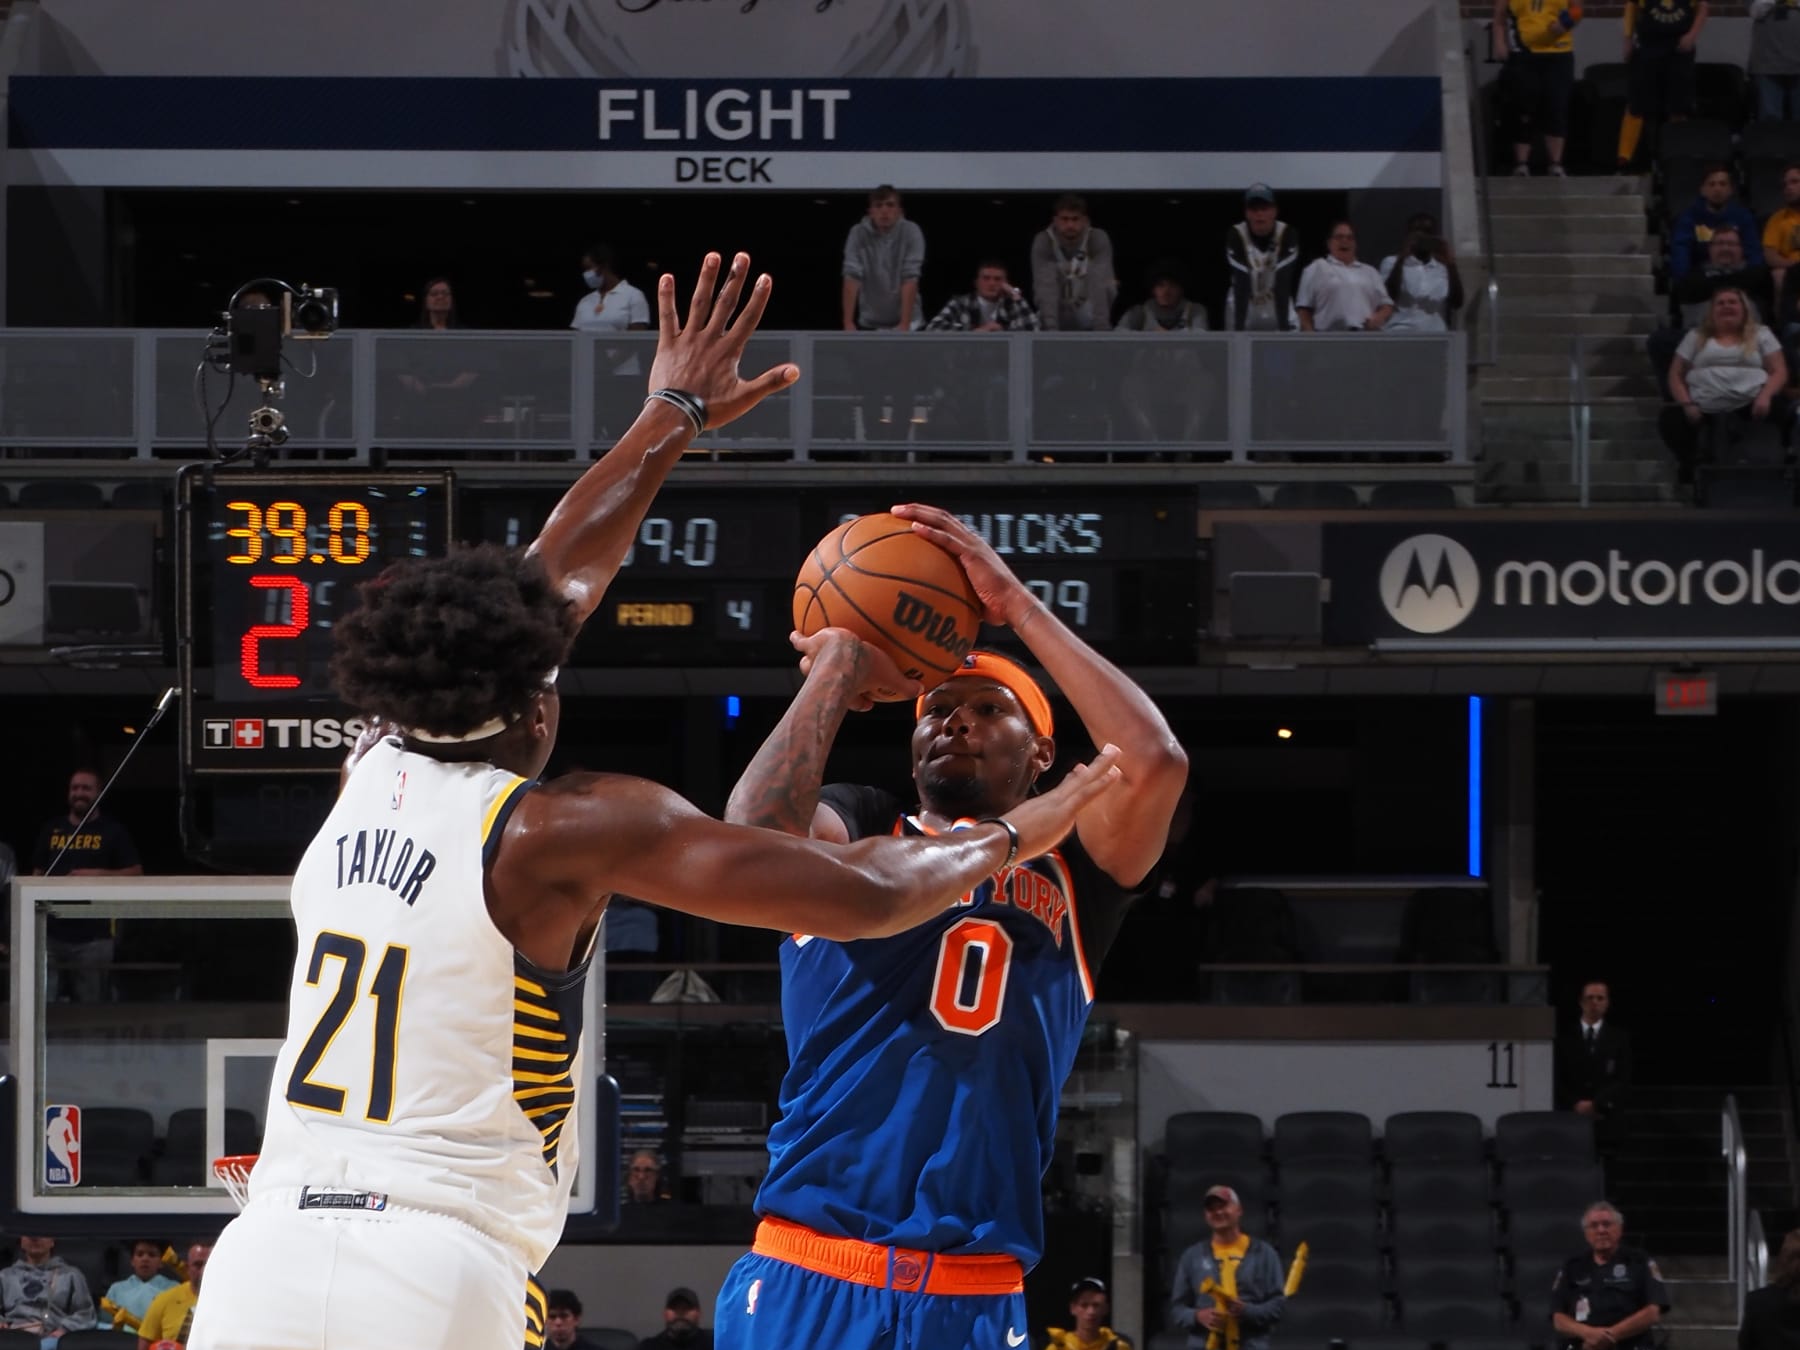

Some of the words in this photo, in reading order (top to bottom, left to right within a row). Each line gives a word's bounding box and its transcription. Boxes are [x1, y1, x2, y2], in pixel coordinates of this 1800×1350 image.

[599, 89, 850, 140] FLIGHT
[676, 157, 772, 182] DECK
[226, 501, 370, 564] 39.0
[620, 518, 717, 566] 9.0
[955, 513, 1102, 553] NICKS
[241, 575, 309, 687] 2
[727, 600, 751, 629] 4
[1667, 680, 1706, 707] EXIT
[336, 829, 436, 906] TAYLOR
[992, 865, 1068, 950] YORK
[929, 916, 1013, 1036] 0
[285, 929, 410, 1124] 21
[1486, 1042, 1518, 1088] 11
[49, 1167, 67, 1181] NBA
